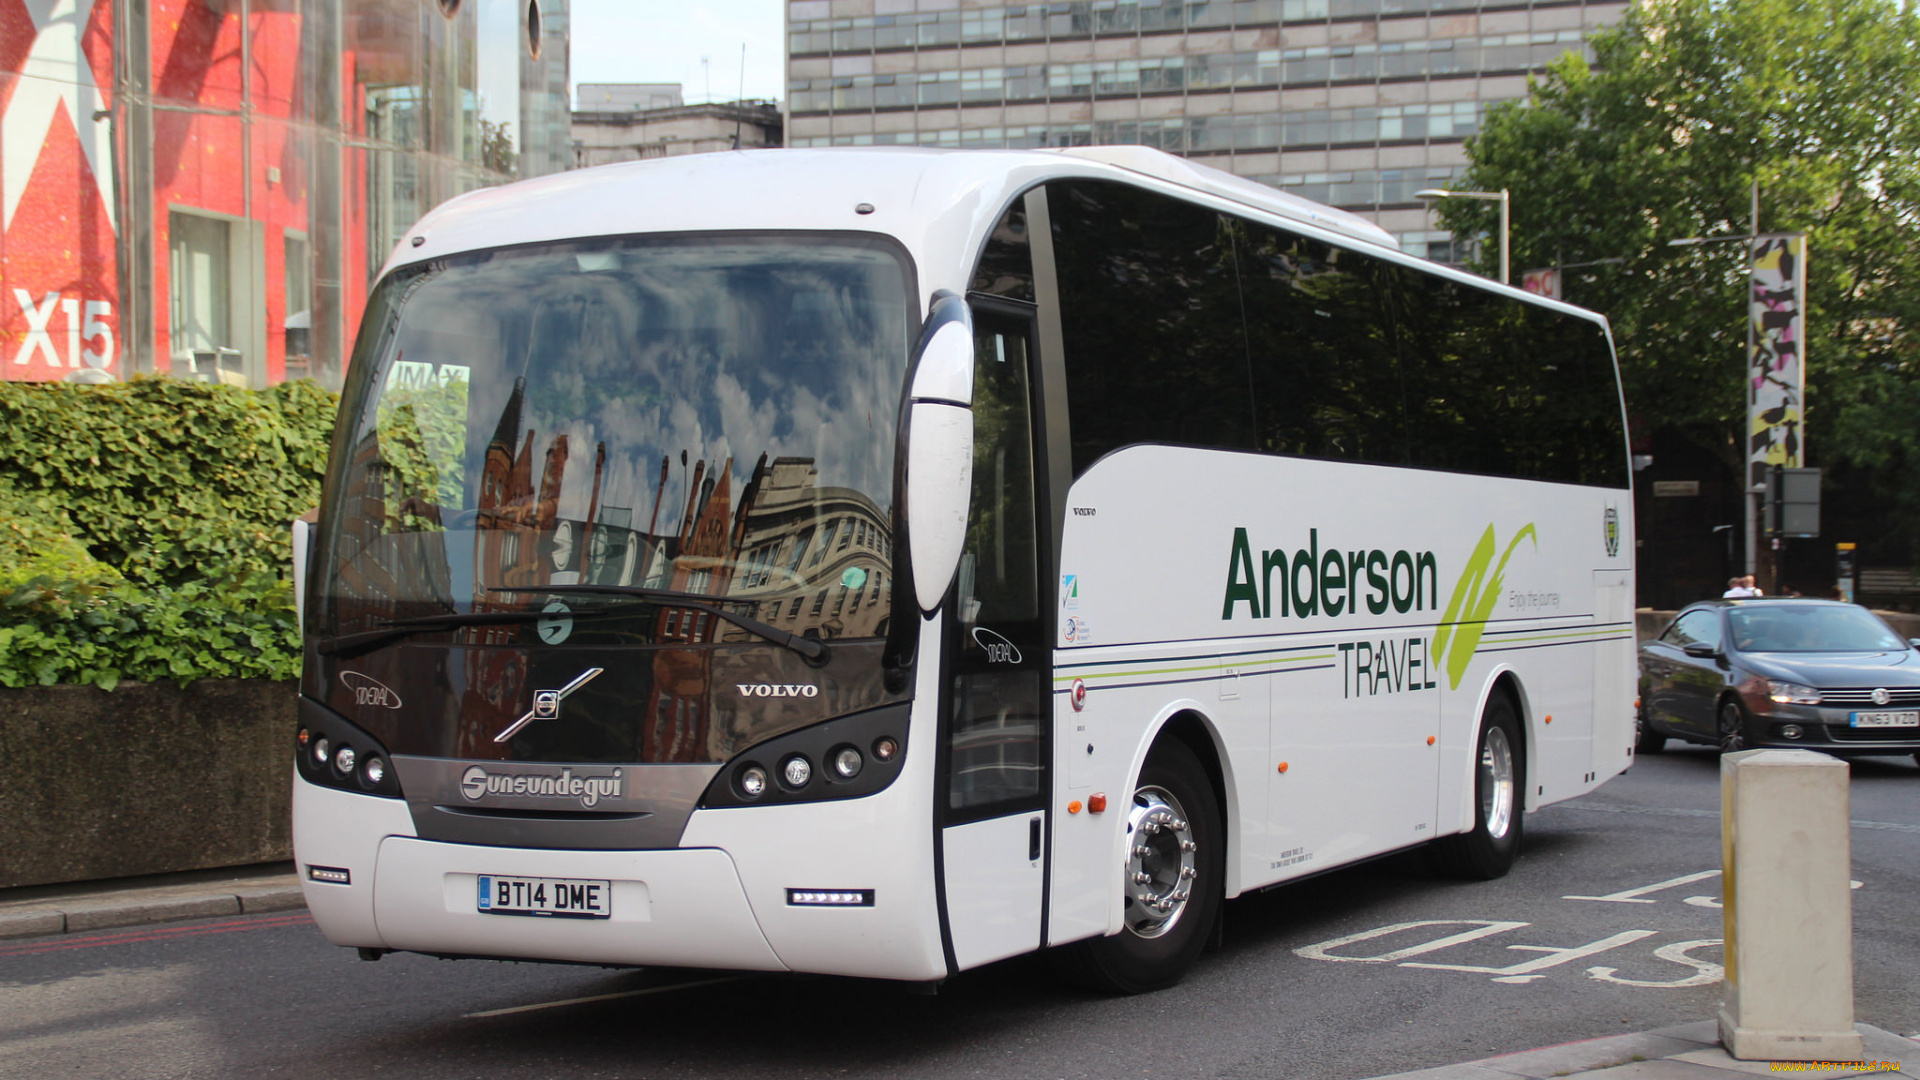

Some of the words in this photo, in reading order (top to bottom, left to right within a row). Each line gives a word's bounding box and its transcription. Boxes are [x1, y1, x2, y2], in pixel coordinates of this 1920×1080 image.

[13, 288, 114, 369] X15
[1222, 527, 1438, 620] Anderson
[736, 684, 818, 698] VOLVO
[1338, 637, 1436, 699] TRAVEL
[461, 766, 622, 808] Sunsundegui
[497, 881, 547, 908] BT14
[555, 883, 601, 911] DME
